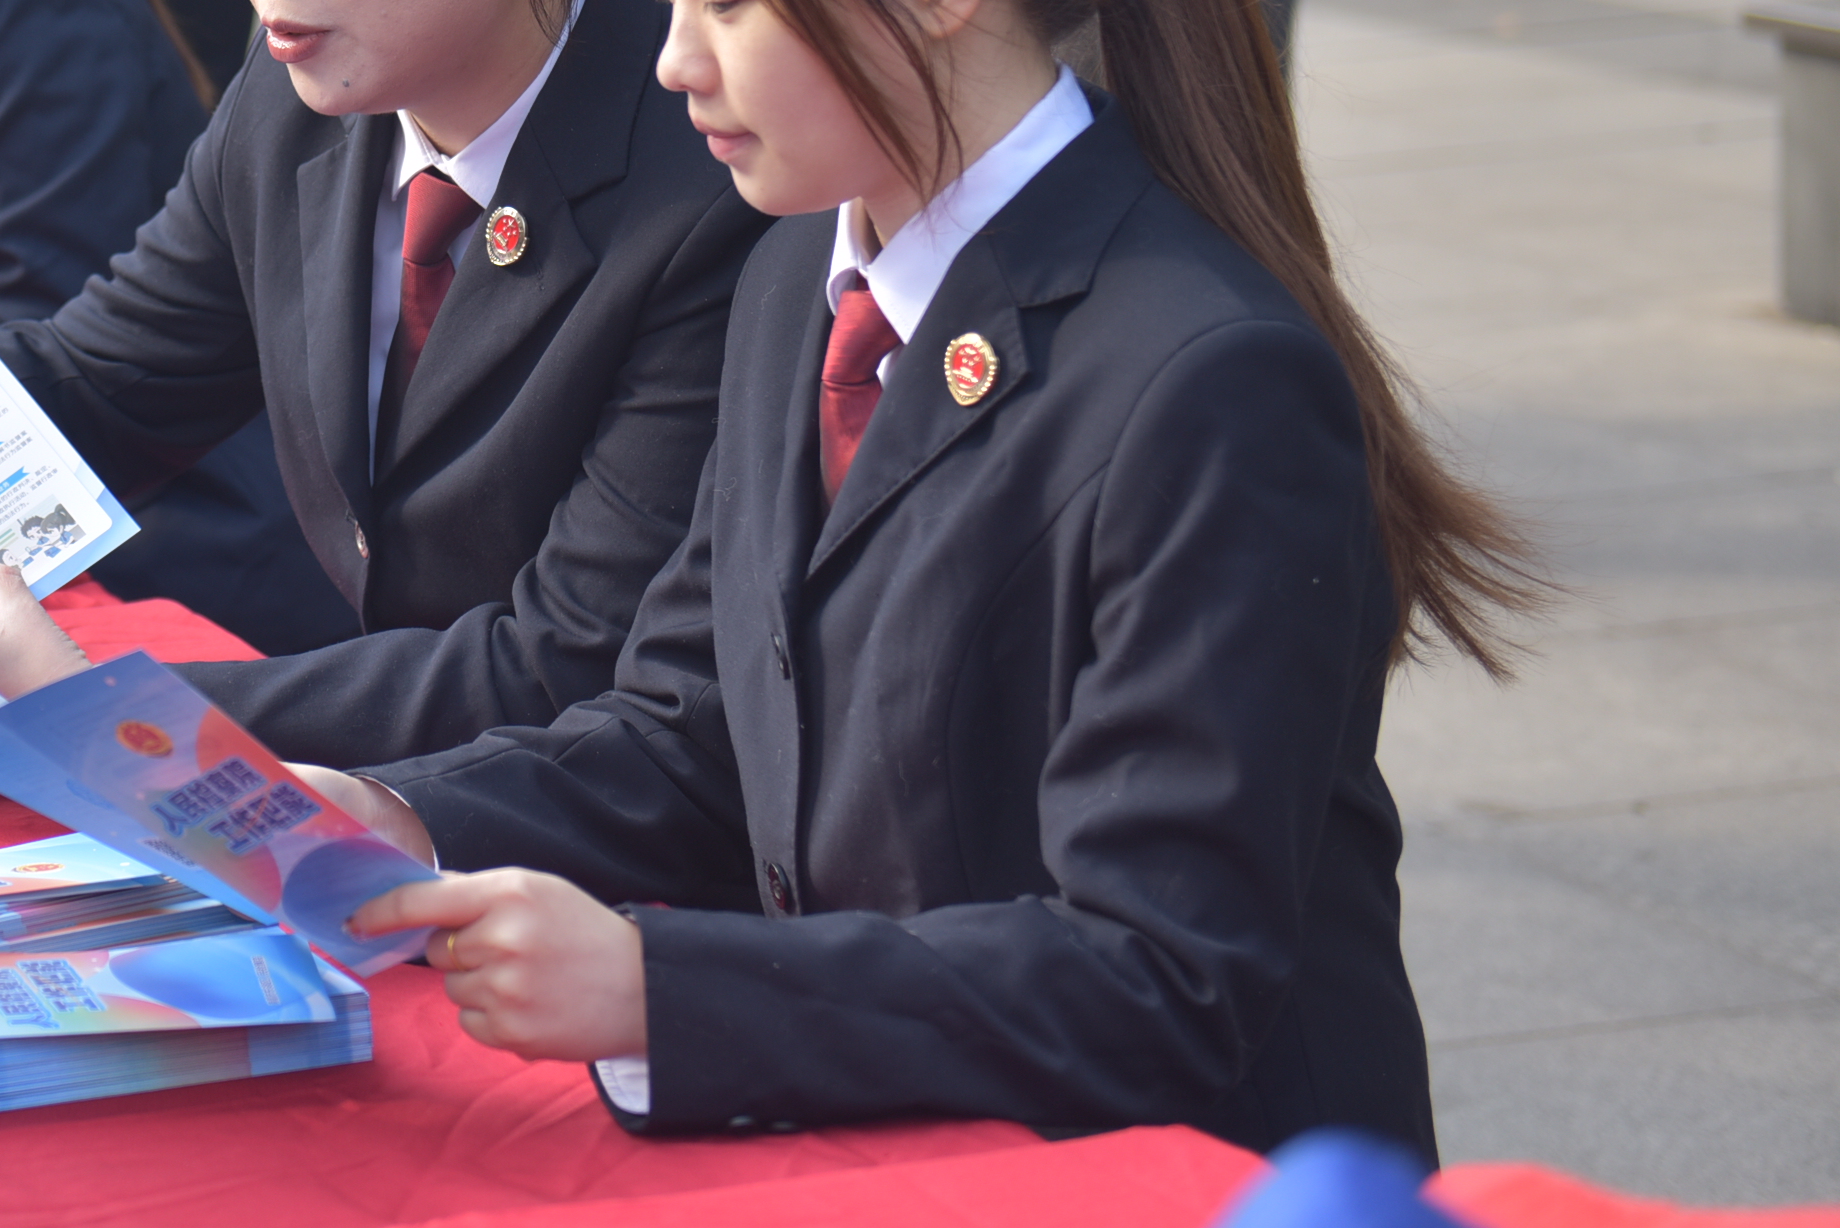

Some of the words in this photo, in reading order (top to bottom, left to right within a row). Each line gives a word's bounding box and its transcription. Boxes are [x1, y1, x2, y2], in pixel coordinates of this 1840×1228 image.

[151, 757, 265, 836] 人民检察院
